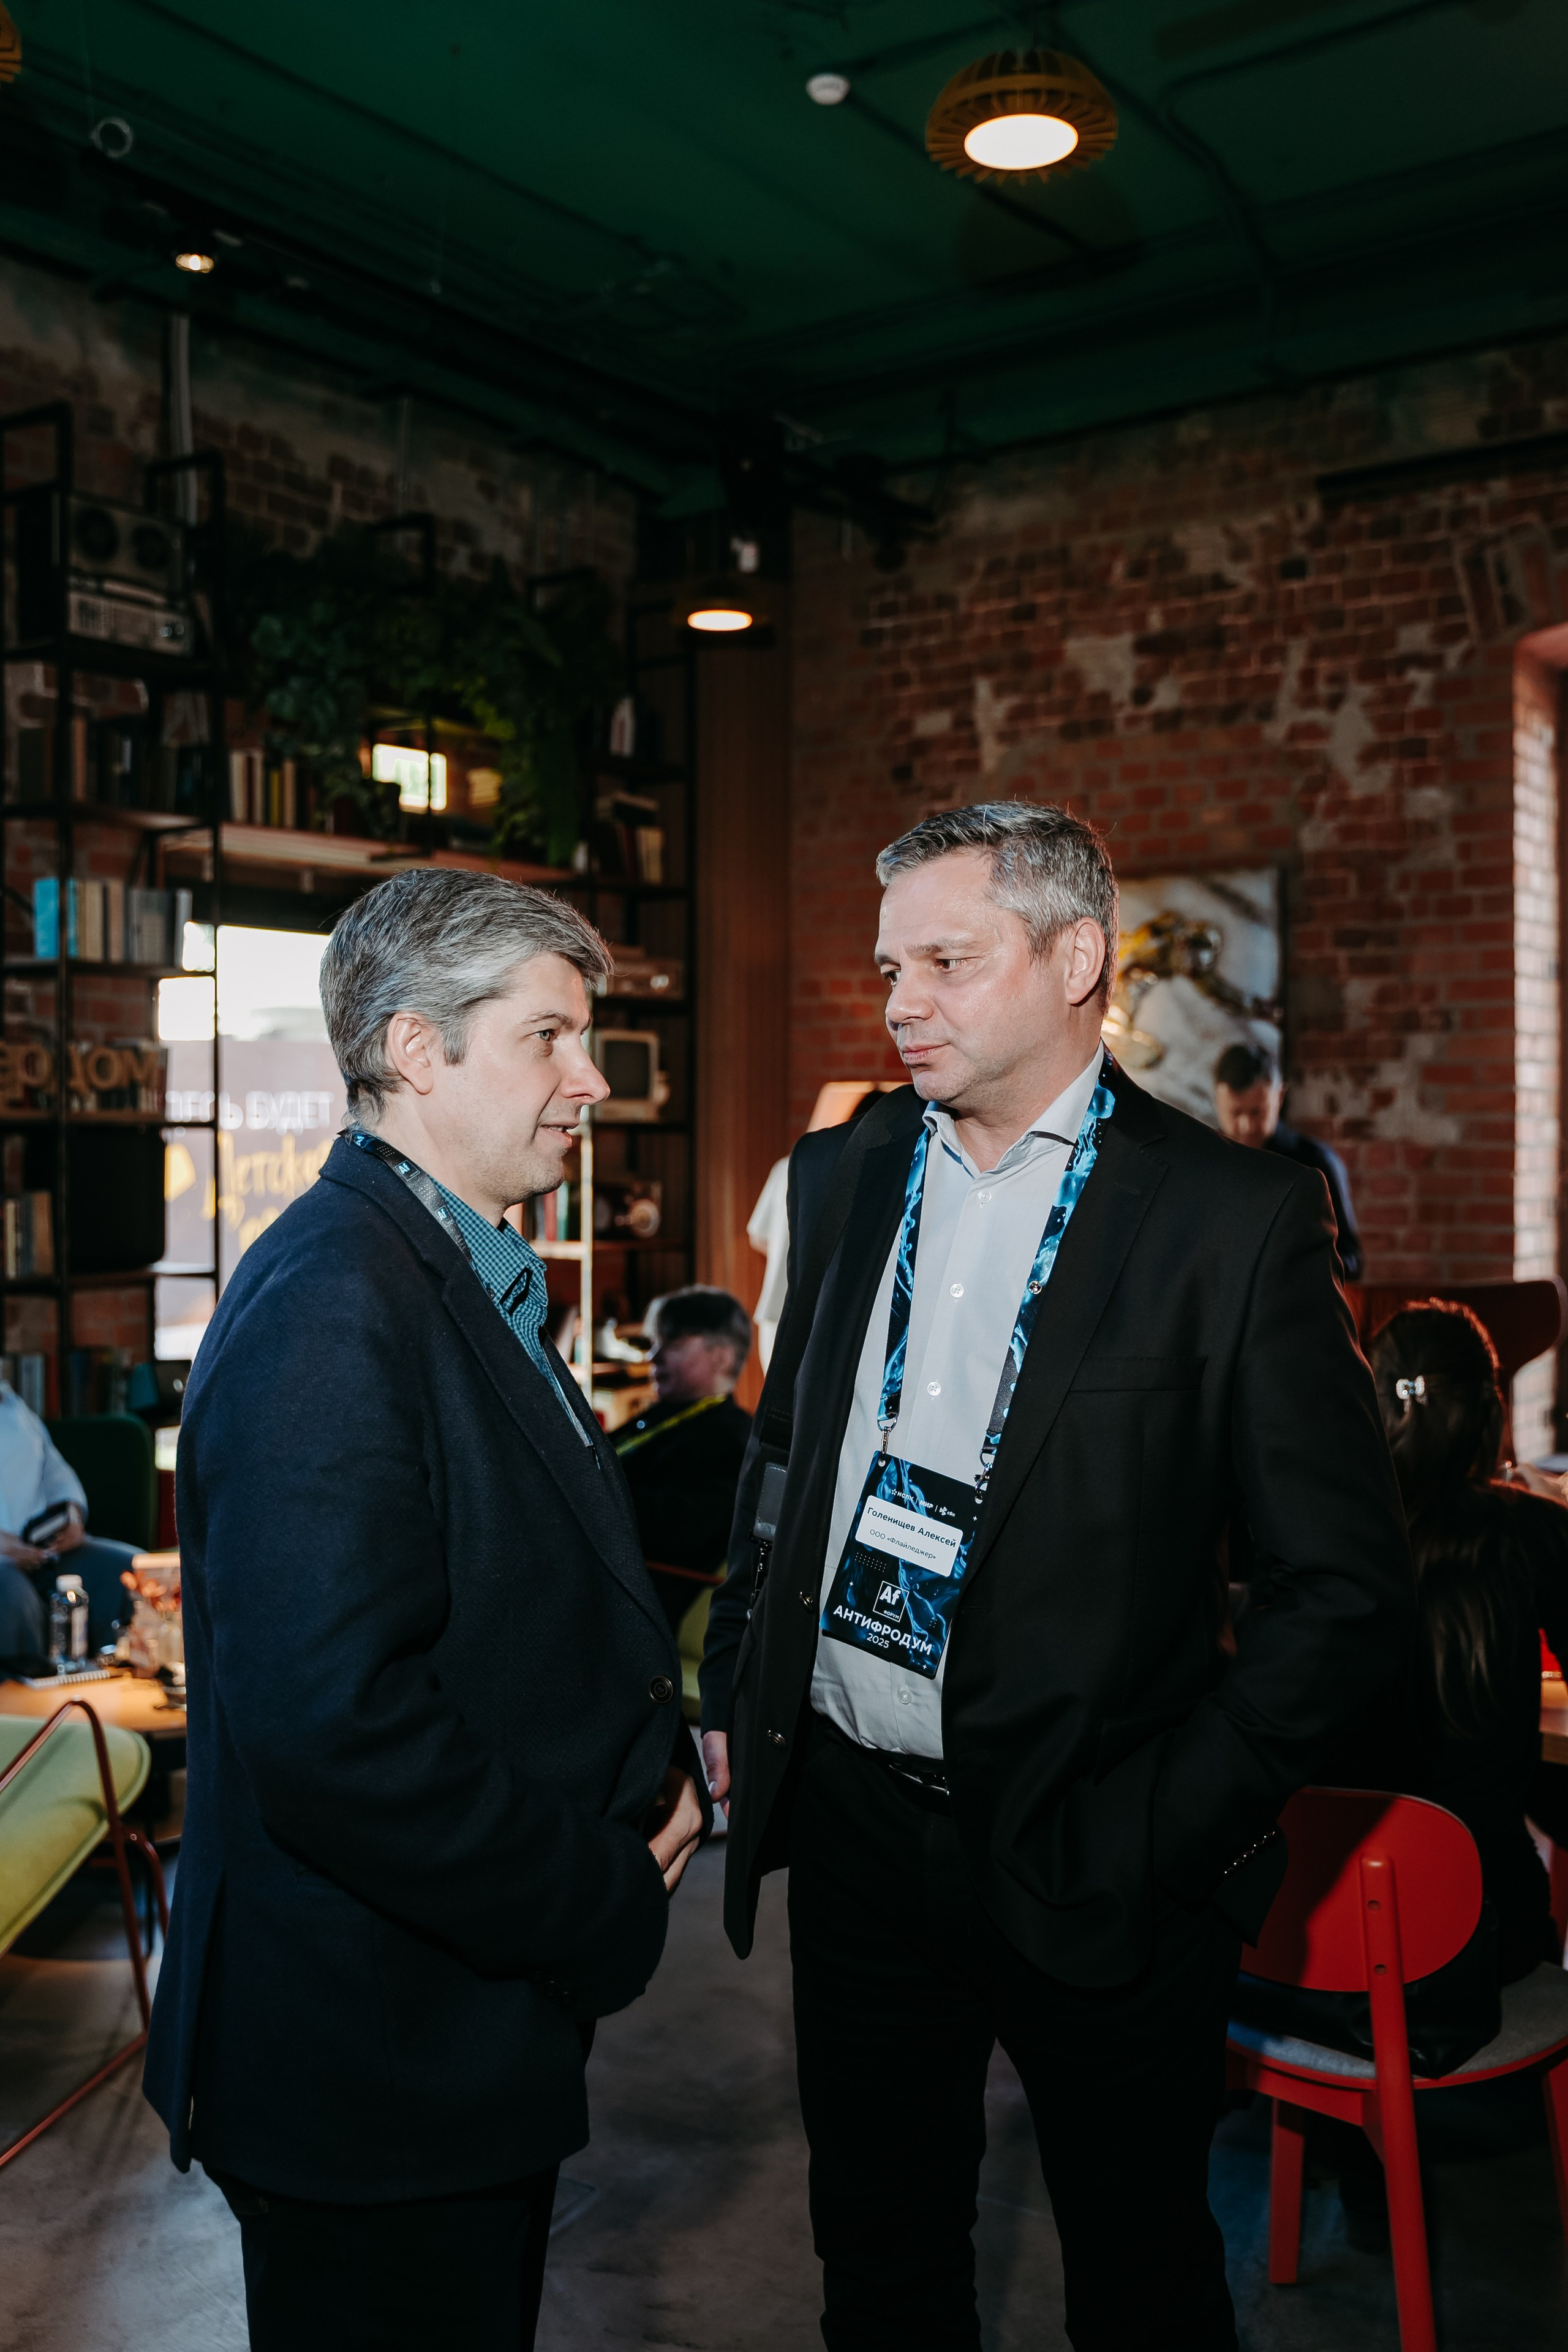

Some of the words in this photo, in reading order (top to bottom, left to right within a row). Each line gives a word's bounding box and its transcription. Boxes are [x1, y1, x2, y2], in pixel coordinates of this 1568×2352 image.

[246, 1091, 335, 1136] БУДЕТ
[897, 1491, 914, 1501] НСПК
[919, 1499, 934, 1509] МИР
[867, 1507, 916, 1531] Голенищев
[917, 1527, 957, 1548] Алексей
[869, 1529, 886, 1540] ООО
[887, 1537, 937, 1559] «Флайледжер»
[879, 1585, 902, 1605] Af
[883, 1610, 900, 1620] ФОРУМ
[833, 1605, 932, 1655] АНТИФРОДУМ
[866, 1632, 890, 1649] 2025
